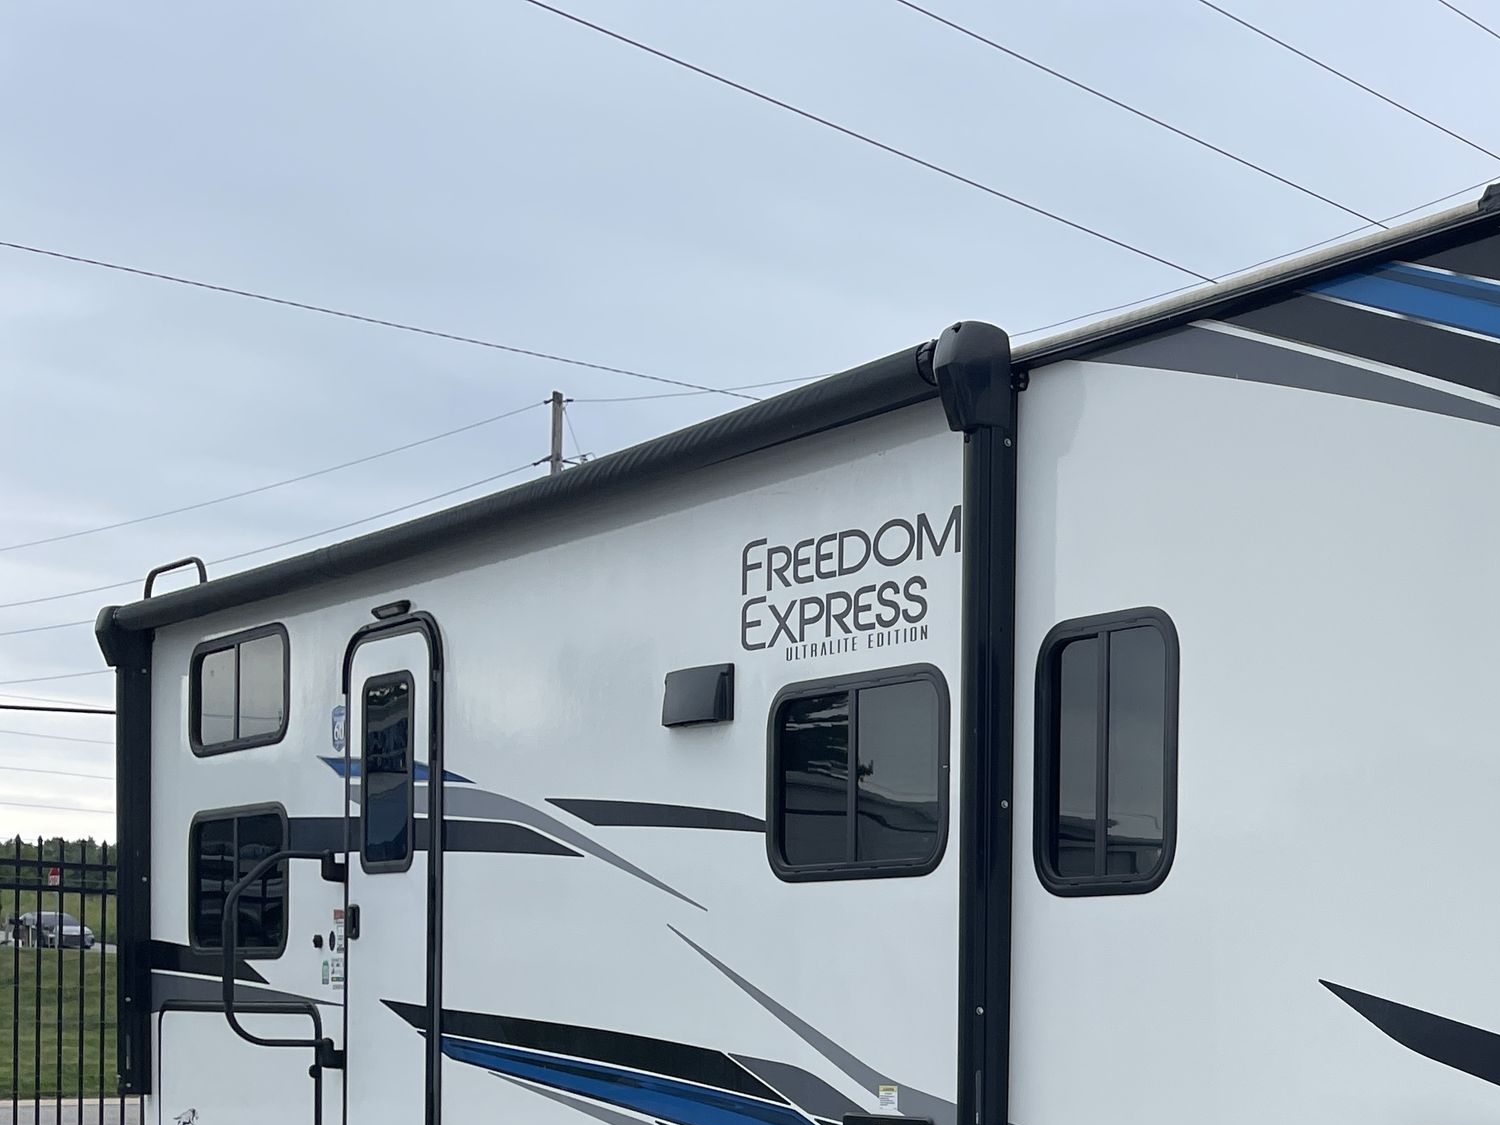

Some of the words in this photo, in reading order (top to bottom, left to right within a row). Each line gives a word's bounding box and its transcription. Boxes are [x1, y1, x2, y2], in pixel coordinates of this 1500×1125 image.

[741, 504, 962, 596] FREEDOM
[741, 575, 928, 652] EXPRESS
[785, 636, 858, 662] ULTRALITE
[867, 624, 929, 649] EDITION
